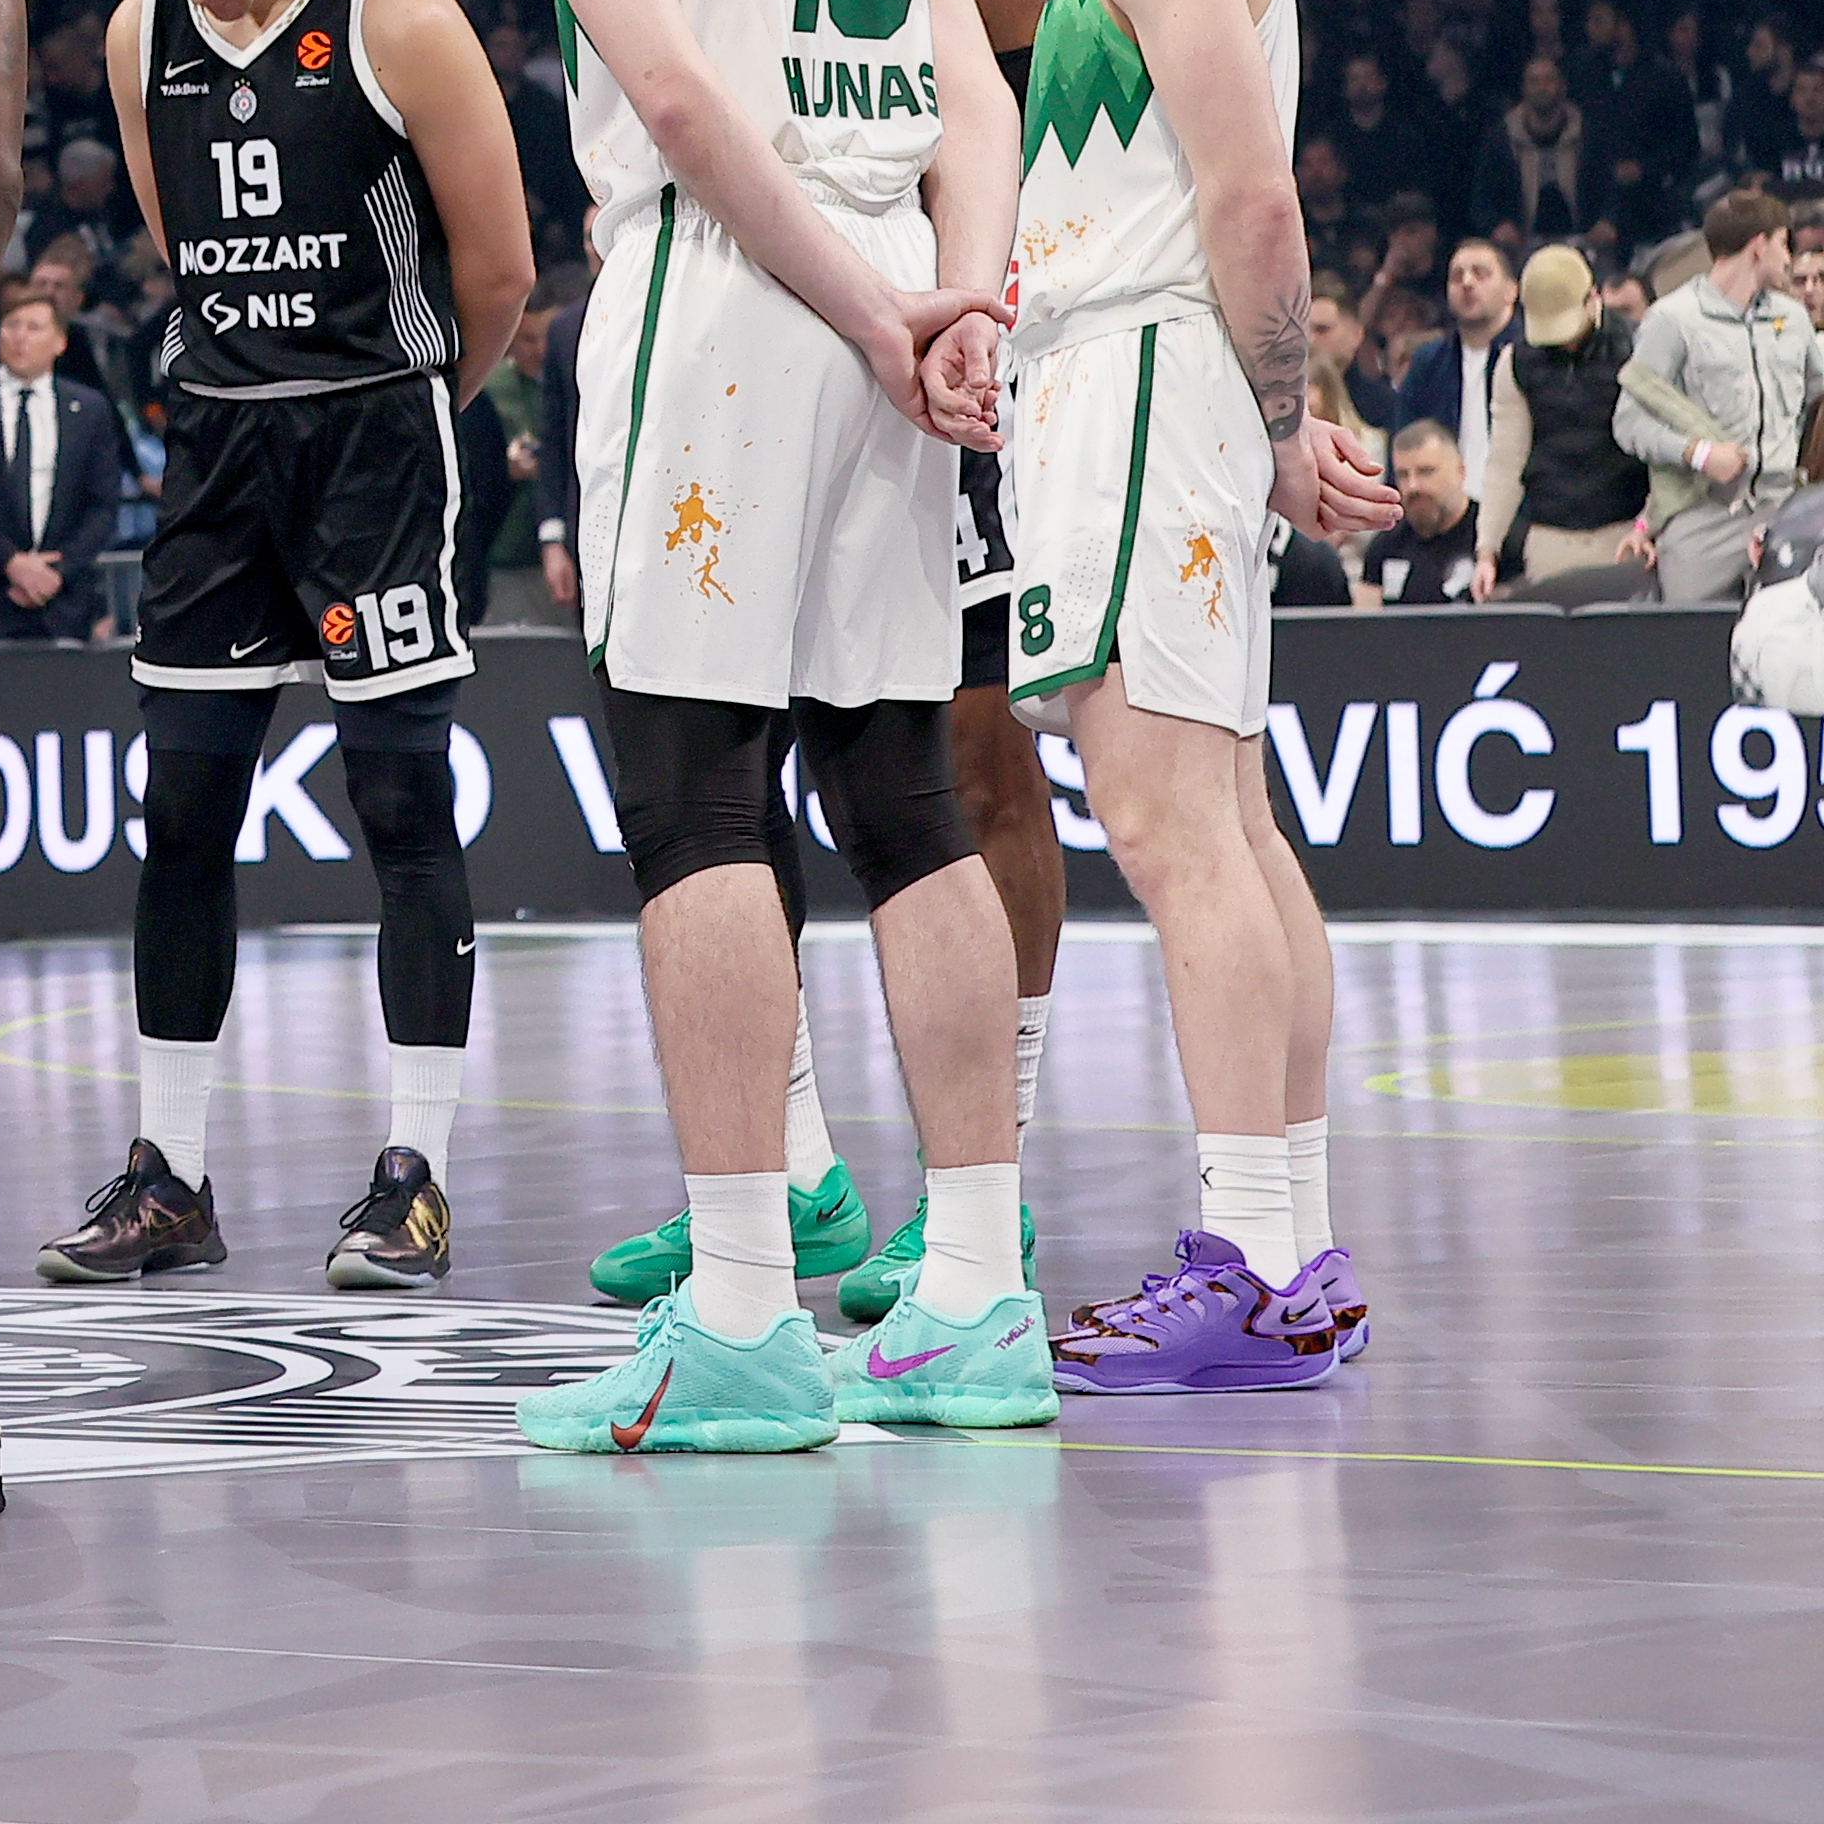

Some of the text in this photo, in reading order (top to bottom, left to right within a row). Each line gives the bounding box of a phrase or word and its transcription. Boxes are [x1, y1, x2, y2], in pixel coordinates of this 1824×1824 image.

[210, 138, 283, 219] 19
[178, 233, 348, 276] MOZZART
[247, 292, 316, 329] NIS
[355, 583, 435, 671] 19
[1017, 583, 1055, 658] 8
[993, 1313, 1036, 1351] TWELVE
